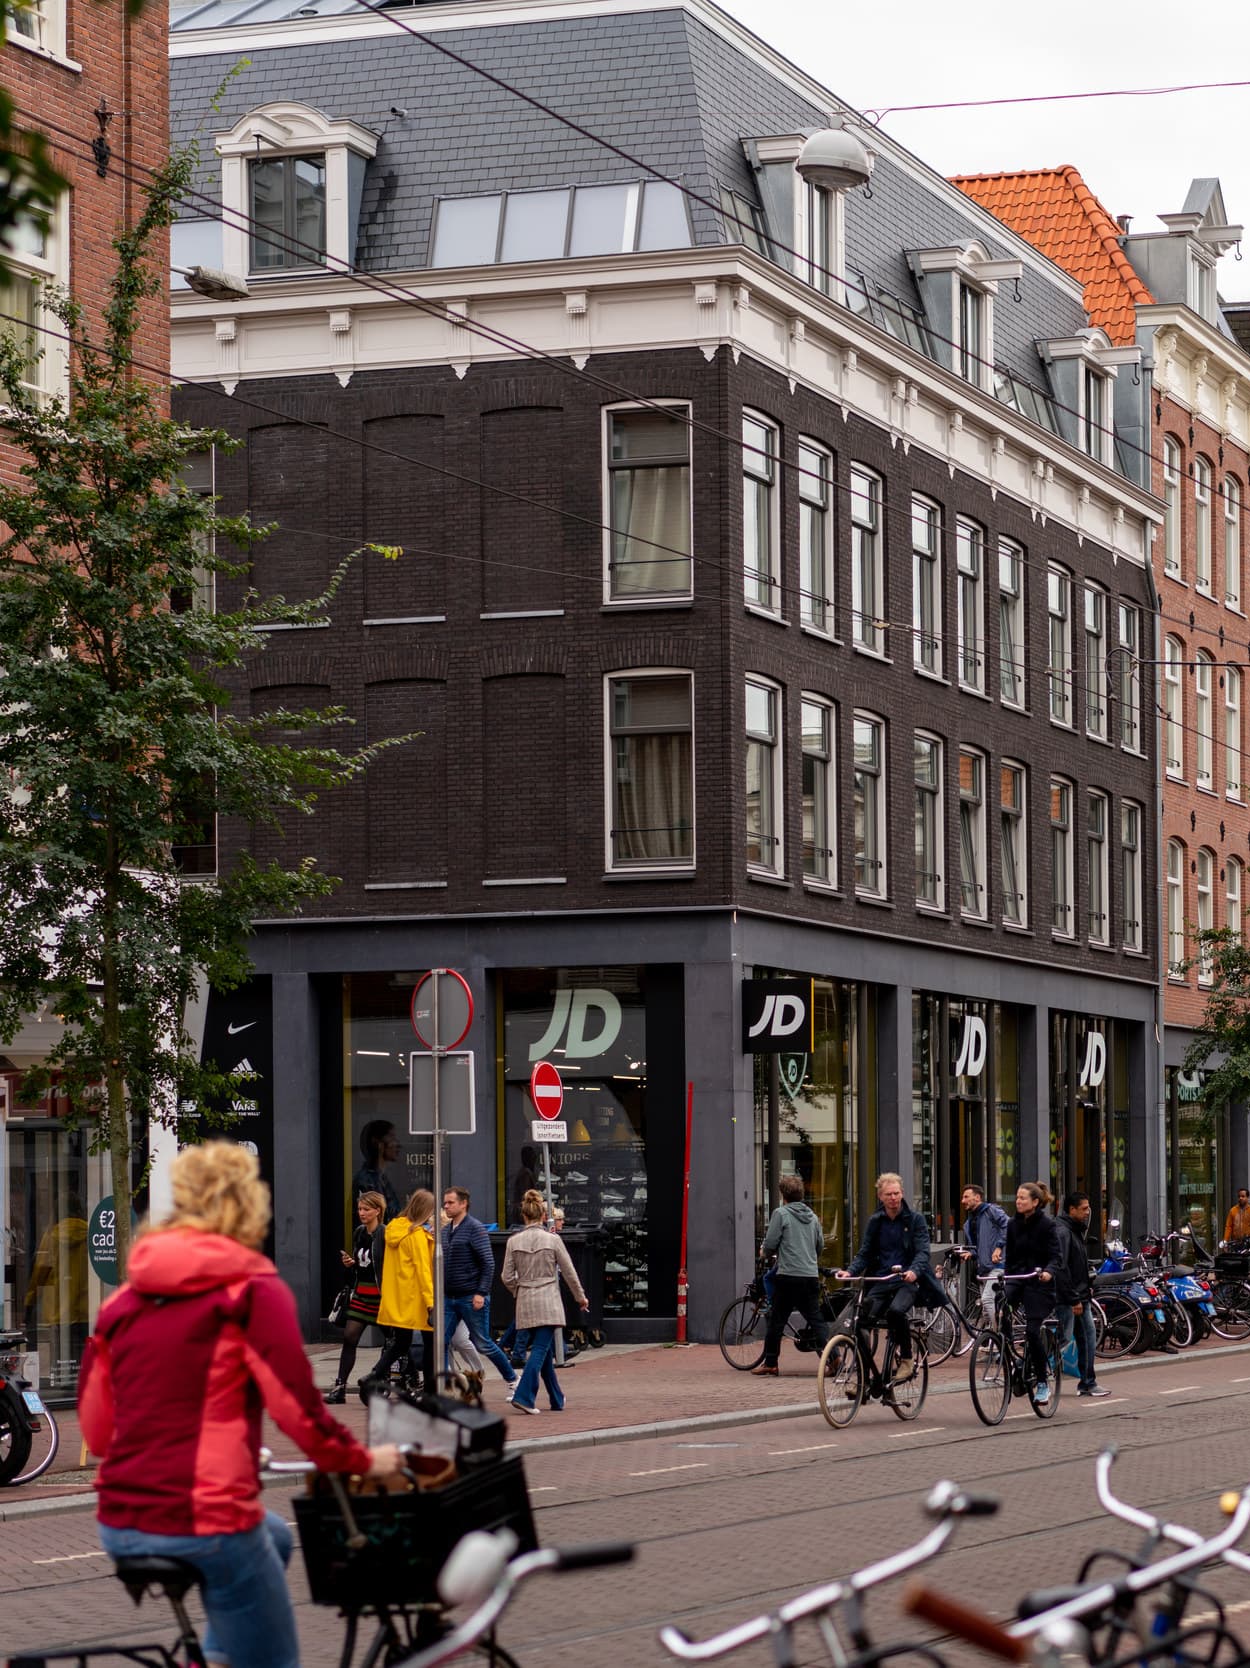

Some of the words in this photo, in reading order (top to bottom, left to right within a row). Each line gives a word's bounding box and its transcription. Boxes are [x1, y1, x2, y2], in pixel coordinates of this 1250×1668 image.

[528, 988, 622, 1061] JD
[748, 995, 806, 1037] JD
[955, 1016, 987, 1077] JD
[1080, 1031, 1106, 1087] JD
